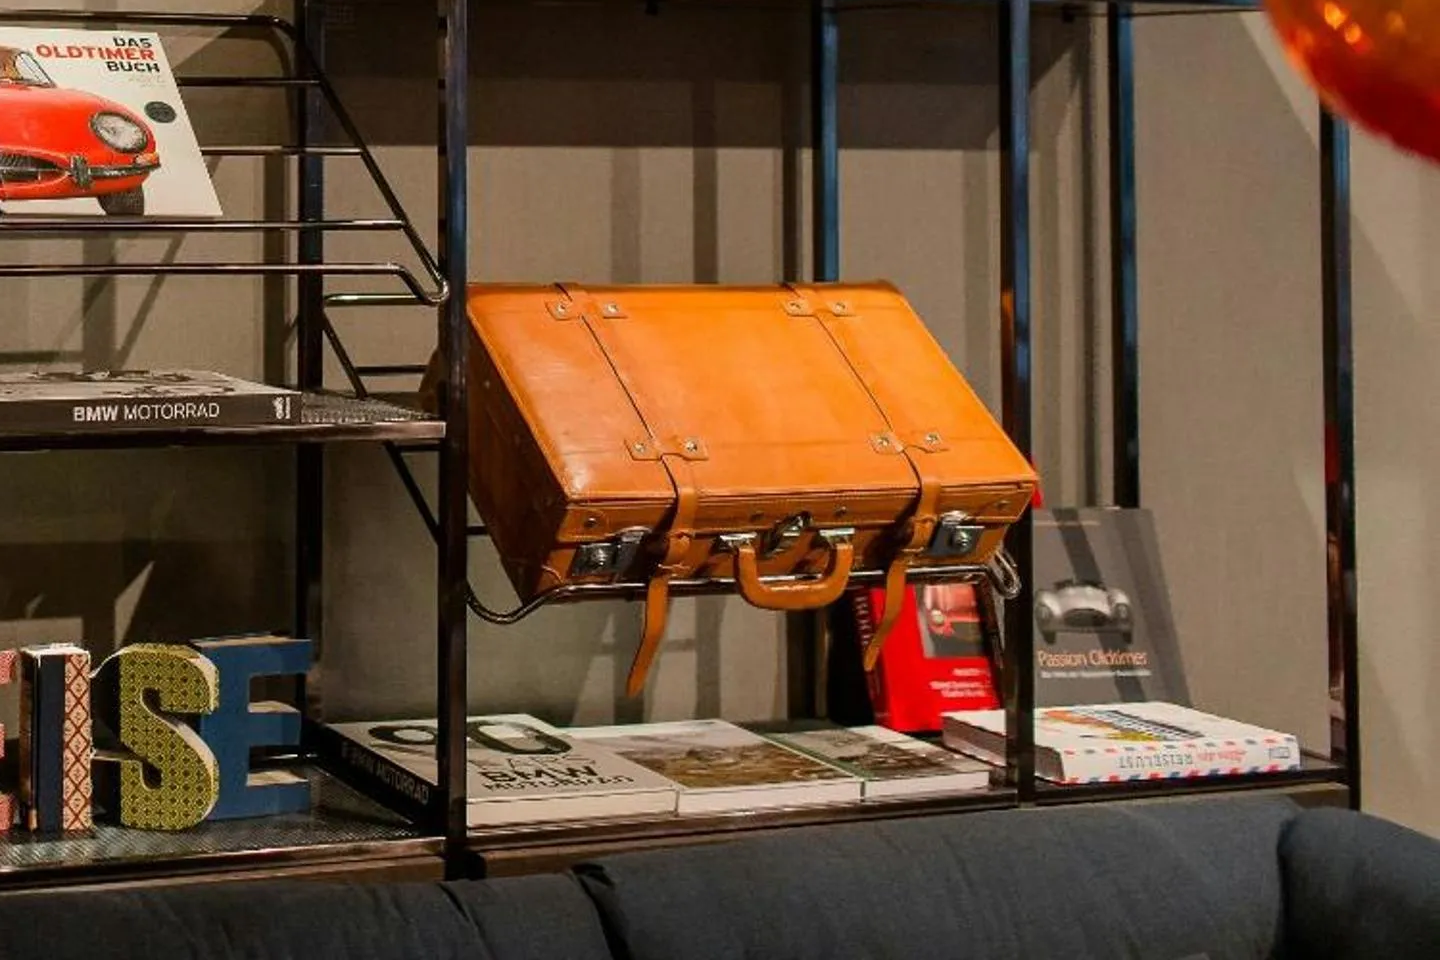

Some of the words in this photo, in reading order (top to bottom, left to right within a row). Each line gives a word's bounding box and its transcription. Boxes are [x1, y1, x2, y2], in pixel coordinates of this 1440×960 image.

[112, 37, 153, 48] DAS
[35, 43, 155, 61] OLDTIMER
[105, 60, 161, 73] BUCH
[72, 405, 119, 422] BMW
[123, 402, 221, 421] MOTORRAD
[478, 765, 598, 783] BMW
